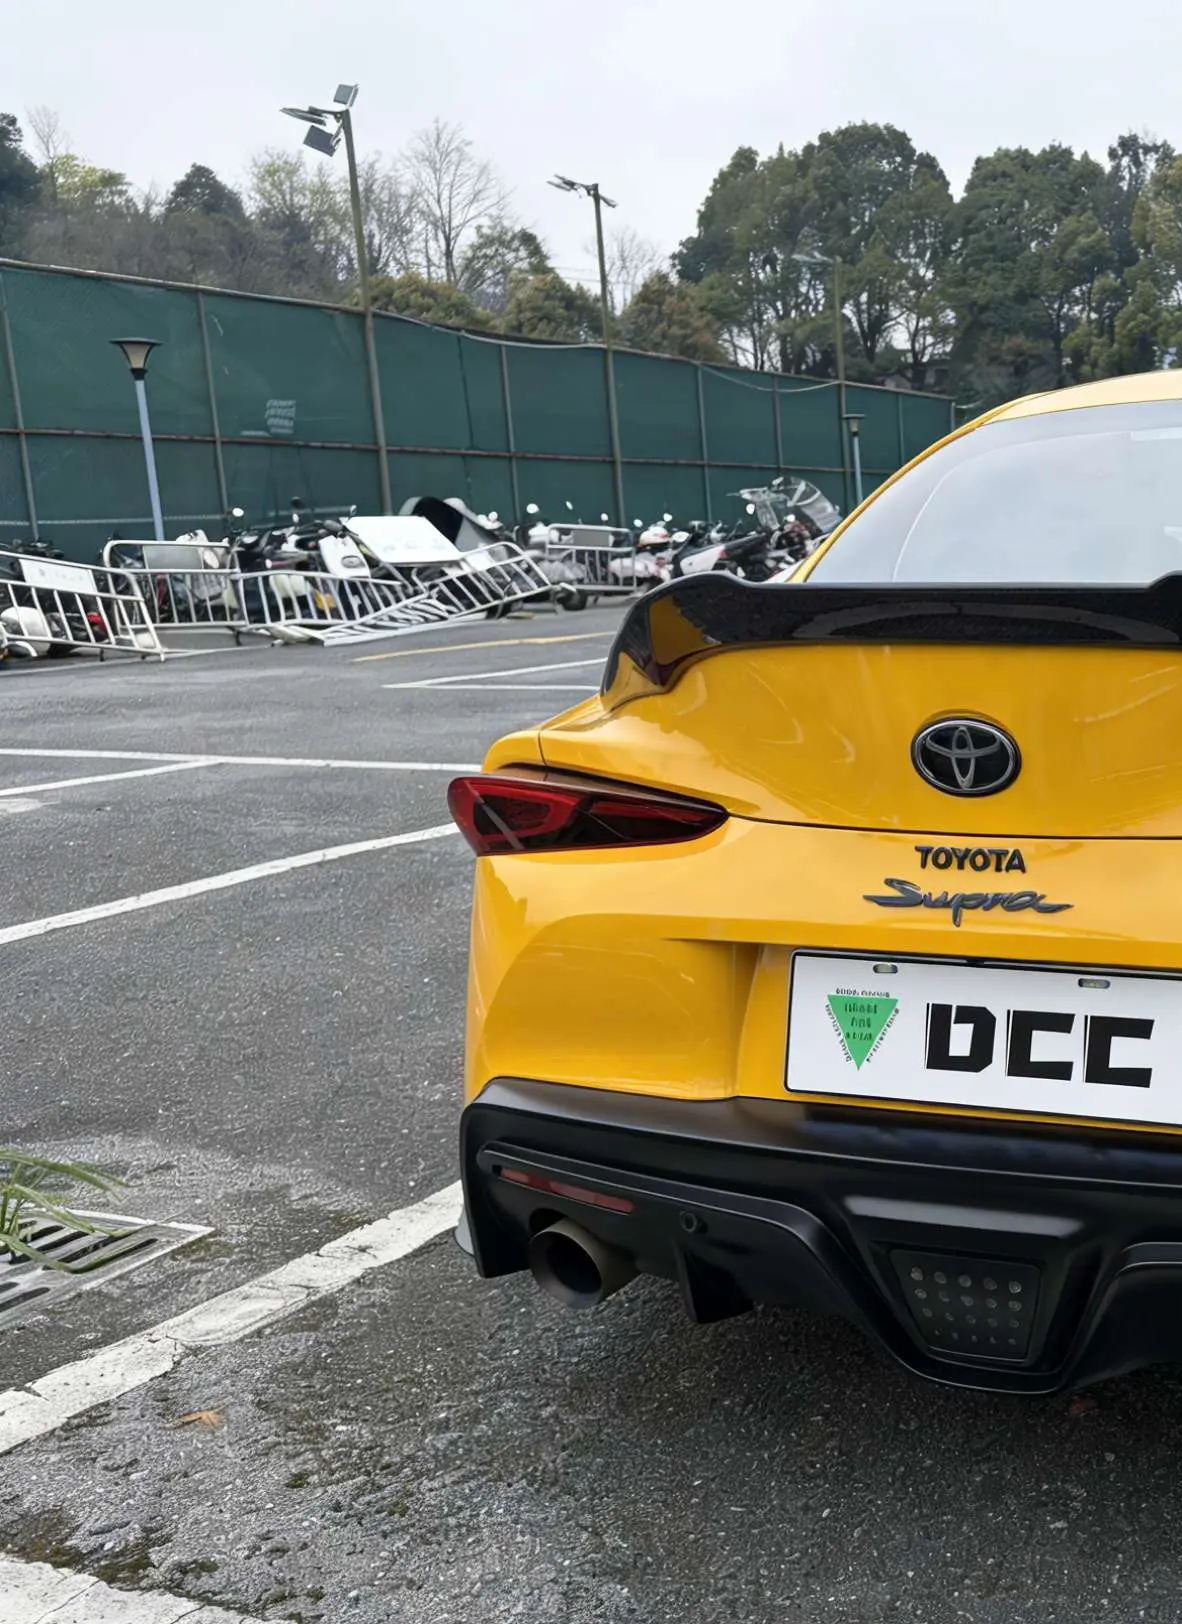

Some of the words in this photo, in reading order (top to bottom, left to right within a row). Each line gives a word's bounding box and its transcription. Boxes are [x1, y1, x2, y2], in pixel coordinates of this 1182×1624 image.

[915, 845, 1026, 873] TOYOTA
[863, 878, 1074, 927] Supra
[925, 1002, 1155, 1088] DCC
